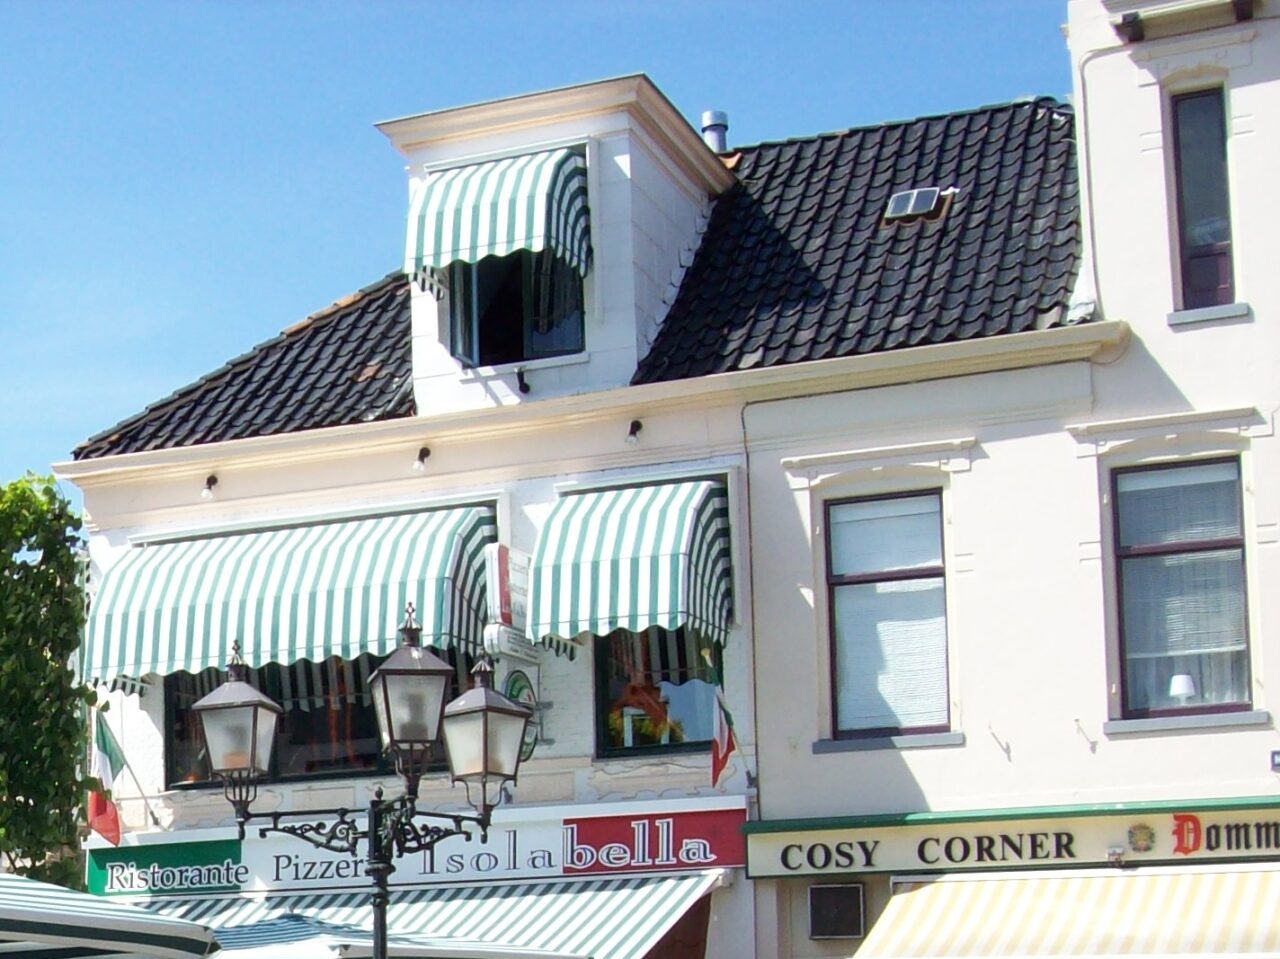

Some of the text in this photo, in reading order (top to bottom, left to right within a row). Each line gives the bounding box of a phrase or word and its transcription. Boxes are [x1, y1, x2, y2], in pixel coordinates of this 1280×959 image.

[780, 831, 1077, 870] COSY CORNER
[107, 860, 250, 890] Ristorante
[272, 853, 372, 882] Pizzer
